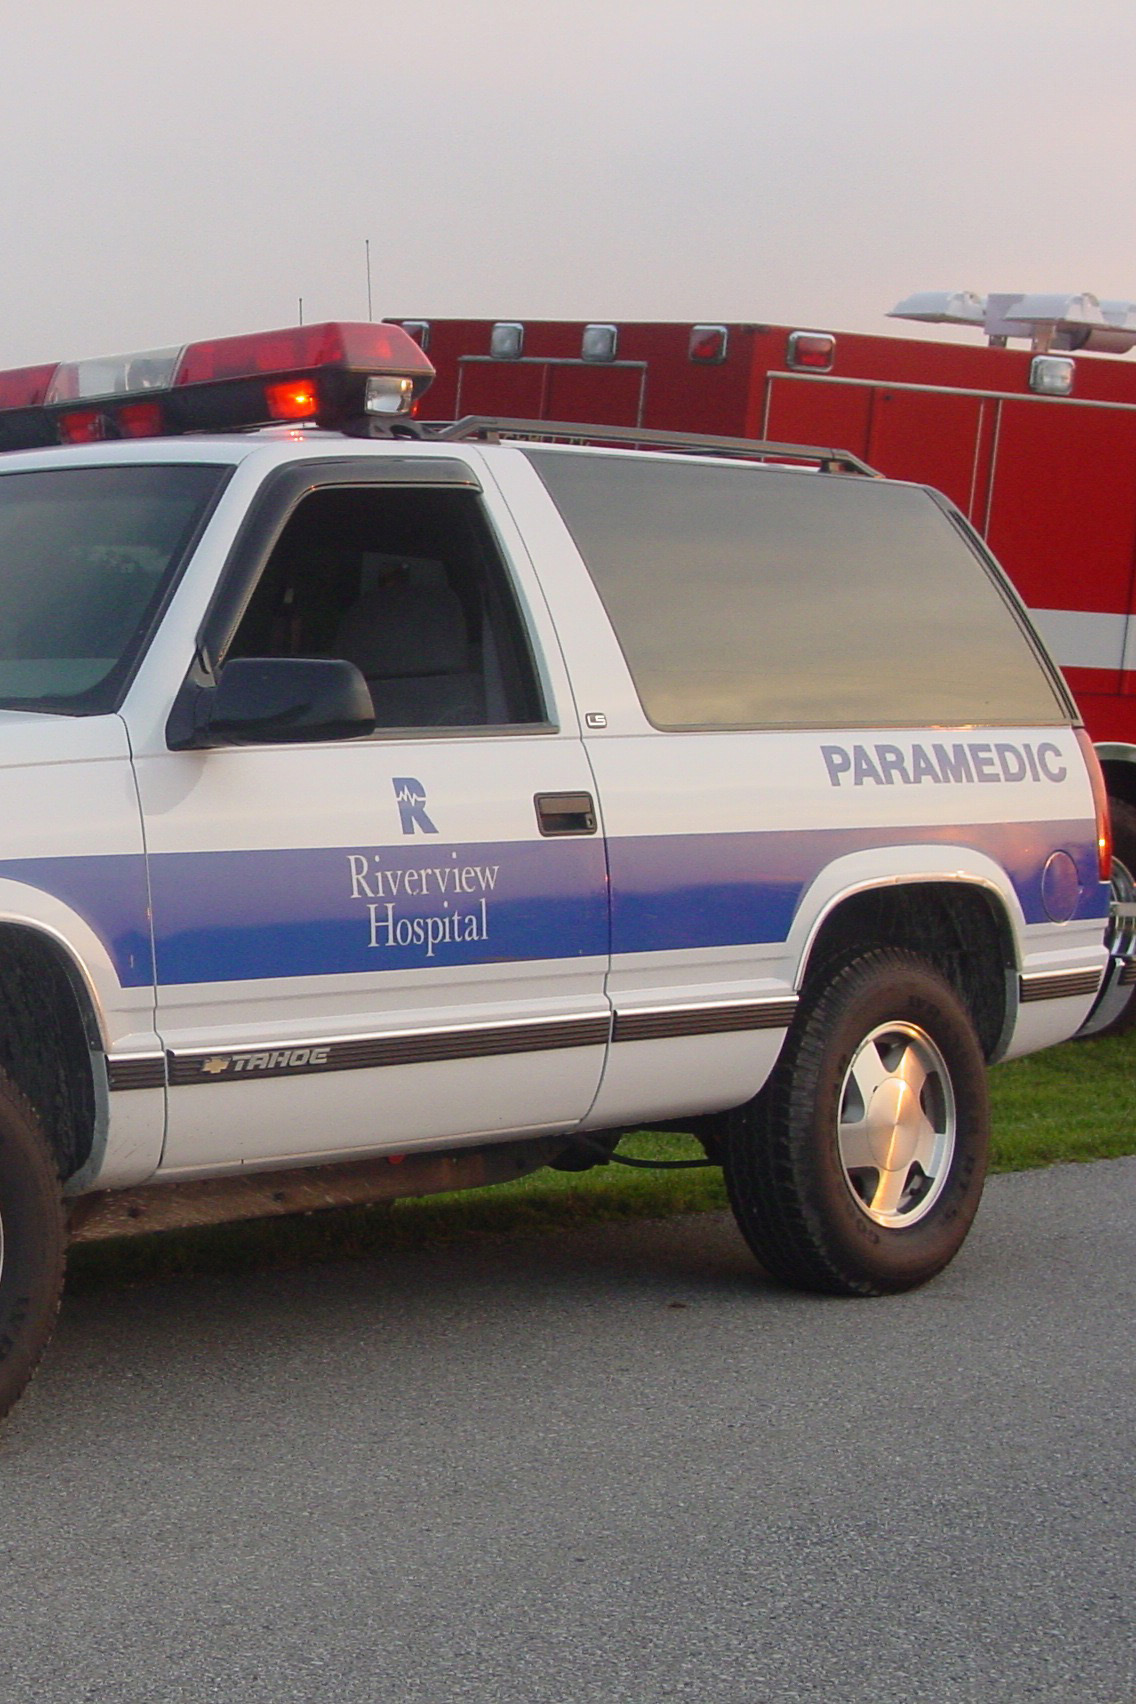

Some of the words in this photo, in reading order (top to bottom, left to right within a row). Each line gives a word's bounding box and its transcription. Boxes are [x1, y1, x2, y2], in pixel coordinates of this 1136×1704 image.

[586, 713, 607, 727] LS
[819, 742, 1068, 787] PARAMEDIC
[392, 777, 439, 835] R
[346, 851, 500, 898] Riverview
[366, 897, 489, 957] Hospital
[231, 1048, 331, 1072] TAHOE
